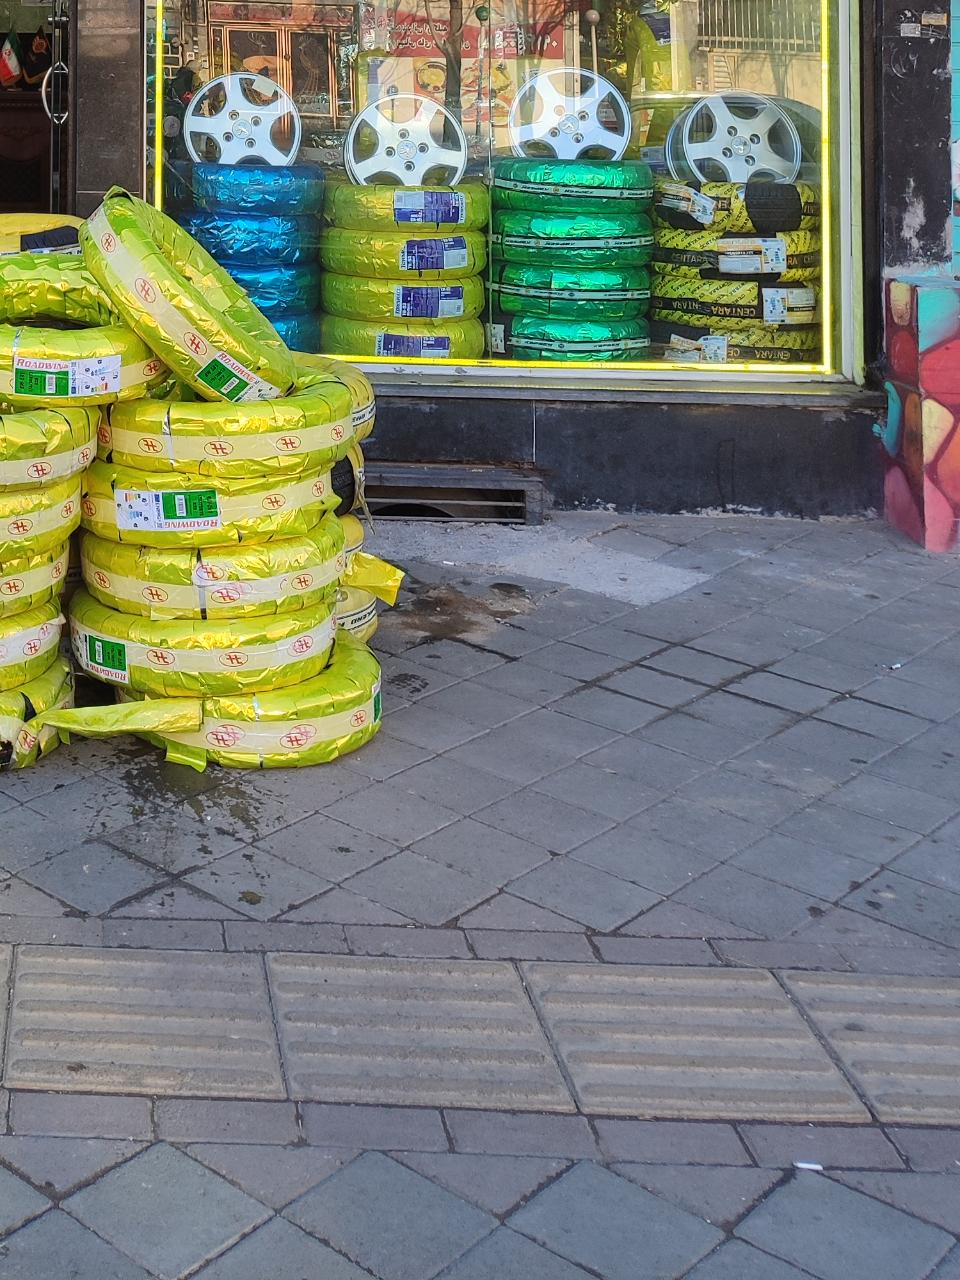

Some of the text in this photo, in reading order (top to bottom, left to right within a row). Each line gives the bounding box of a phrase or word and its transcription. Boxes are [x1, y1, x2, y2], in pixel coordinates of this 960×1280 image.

[711, 306, 756, 317] CENTARA
[218, 352, 257, 383] ROADWING
[164, 519, 218, 529] ROADWING
